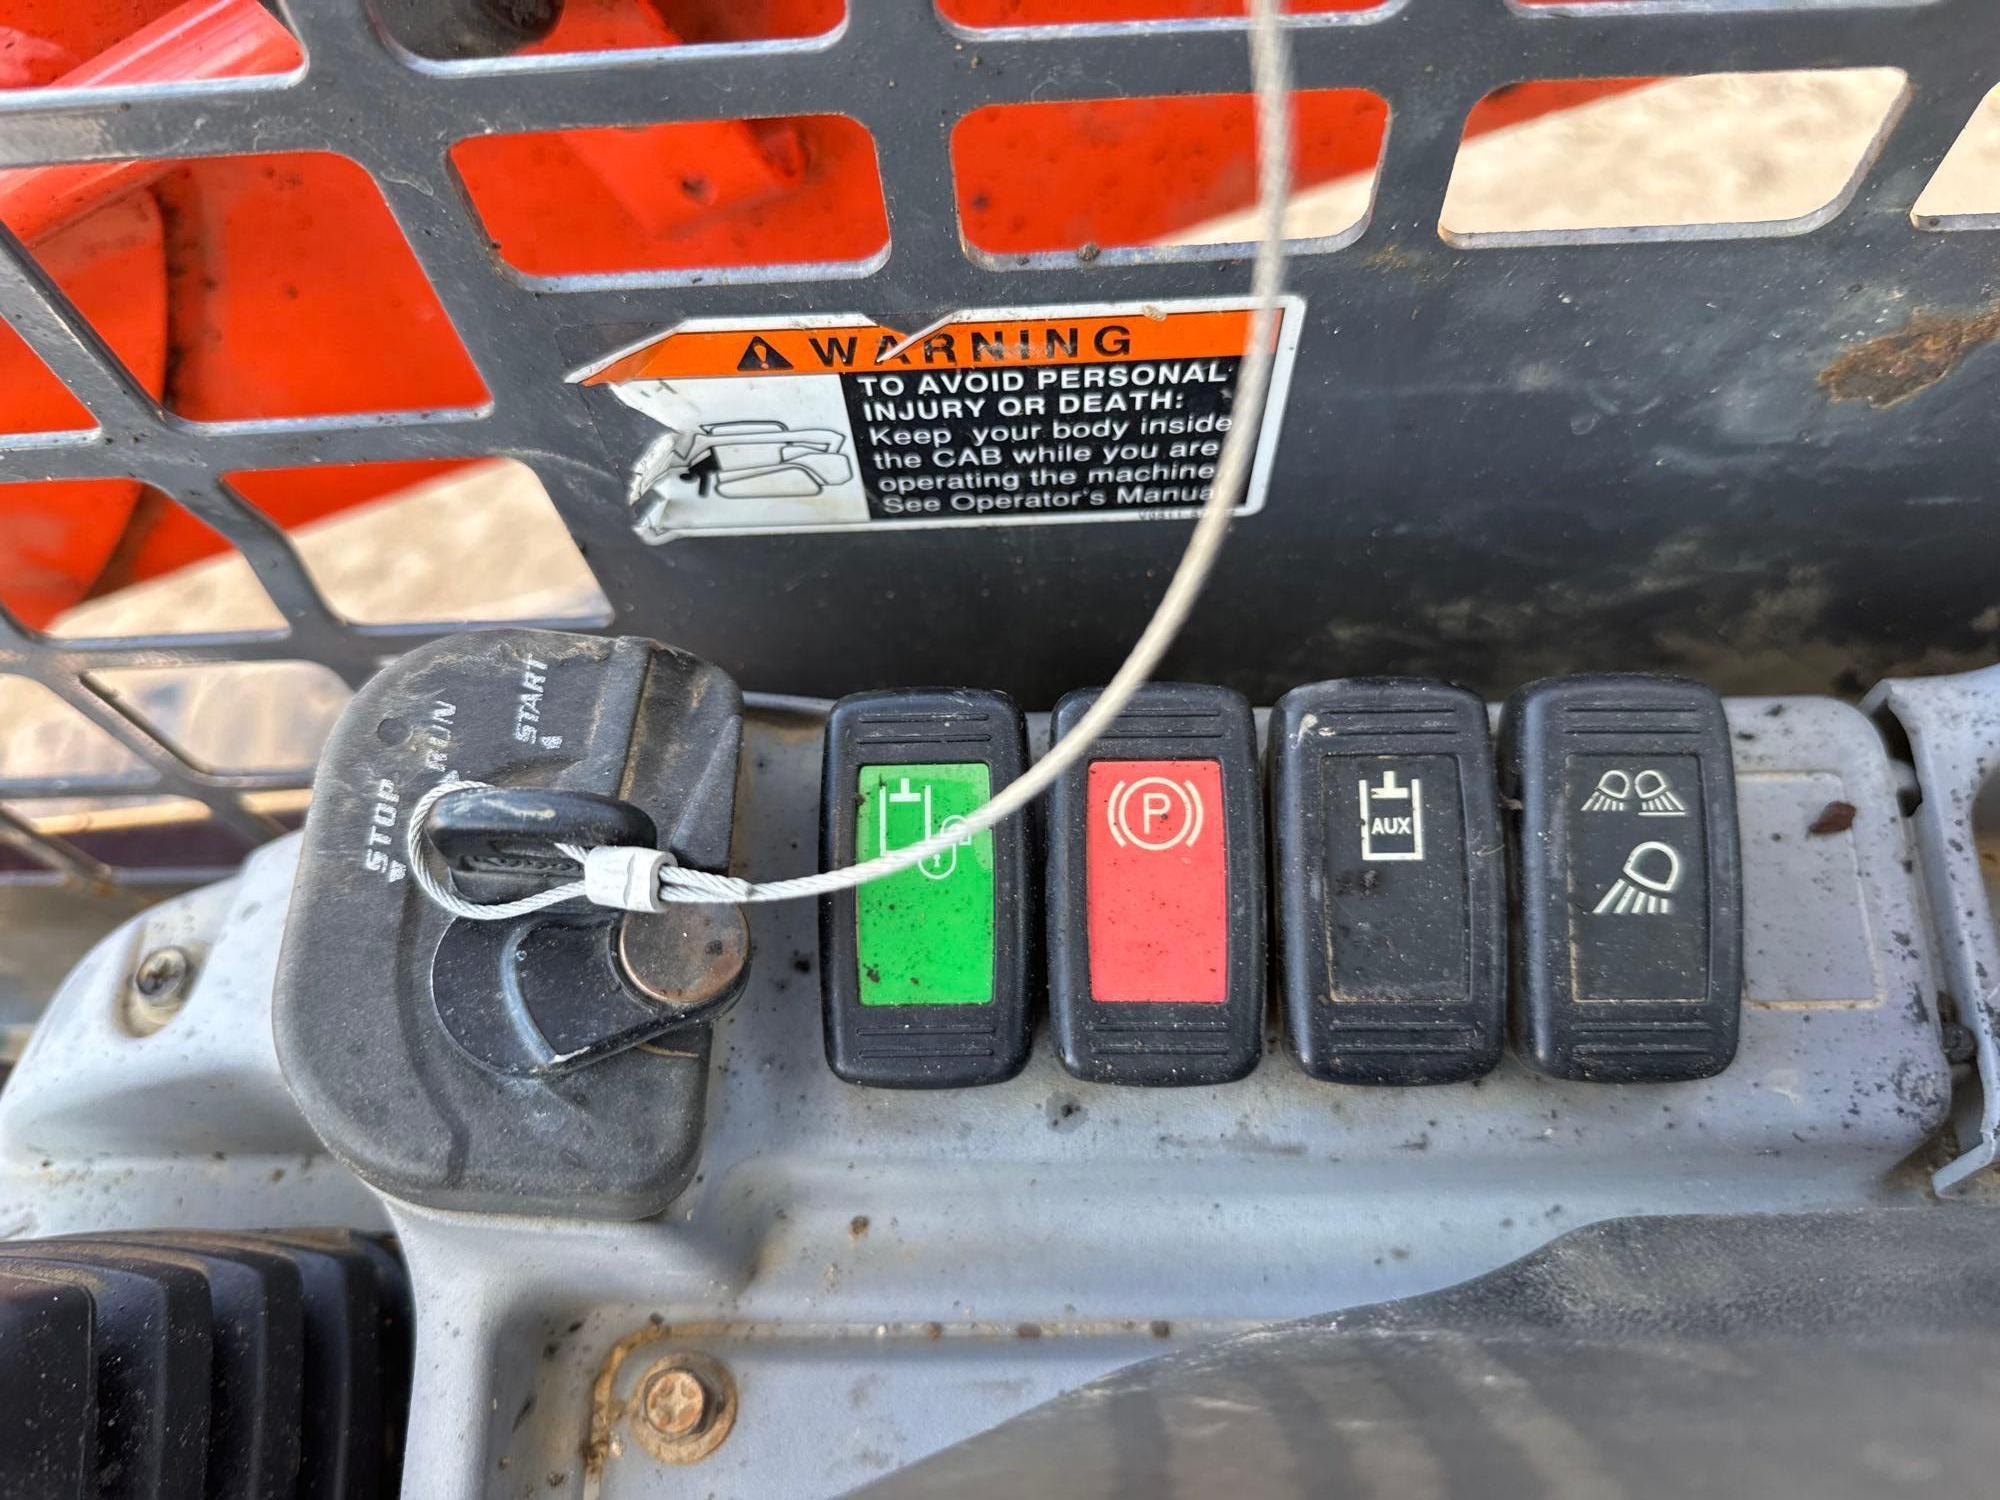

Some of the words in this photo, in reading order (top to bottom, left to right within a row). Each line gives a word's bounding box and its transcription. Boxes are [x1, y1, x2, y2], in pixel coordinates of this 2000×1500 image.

[809, 325, 1131, 367] WARNING
[857, 375, 905, 397] TO
[917, 370, 1024, 395] AVOID
[1037, 361, 1227, 390] PERSONAL
[863, 398, 985, 422] INJURY
[998, 396, 1046, 417] OR
[1058, 390, 1184, 414] DEATH:
[868, 426, 952, 448] Keep
[972, 424, 1042, 446] your
[1052, 417, 1130, 441] body
[1140, 412, 1233, 435] inside
[873, 451, 922, 470] the
[932, 447, 1002, 468] CAB
[1012, 442, 1092, 464] while
[1102, 443, 1159, 465] you
[1168, 440, 1219, 458] are
[878, 471, 1020, 495] operating
[1030, 466, 1077, 486] the
[883, 495, 941, 513] See
[950, 488, 1107, 513] Operator's
[1117, 485, 1219, 504] Manua
[514, 655, 548, 744] START
[425, 700, 456, 772] RUN
[365, 778, 400, 873] STOP
[1371, 817, 1411, 835] AUX
